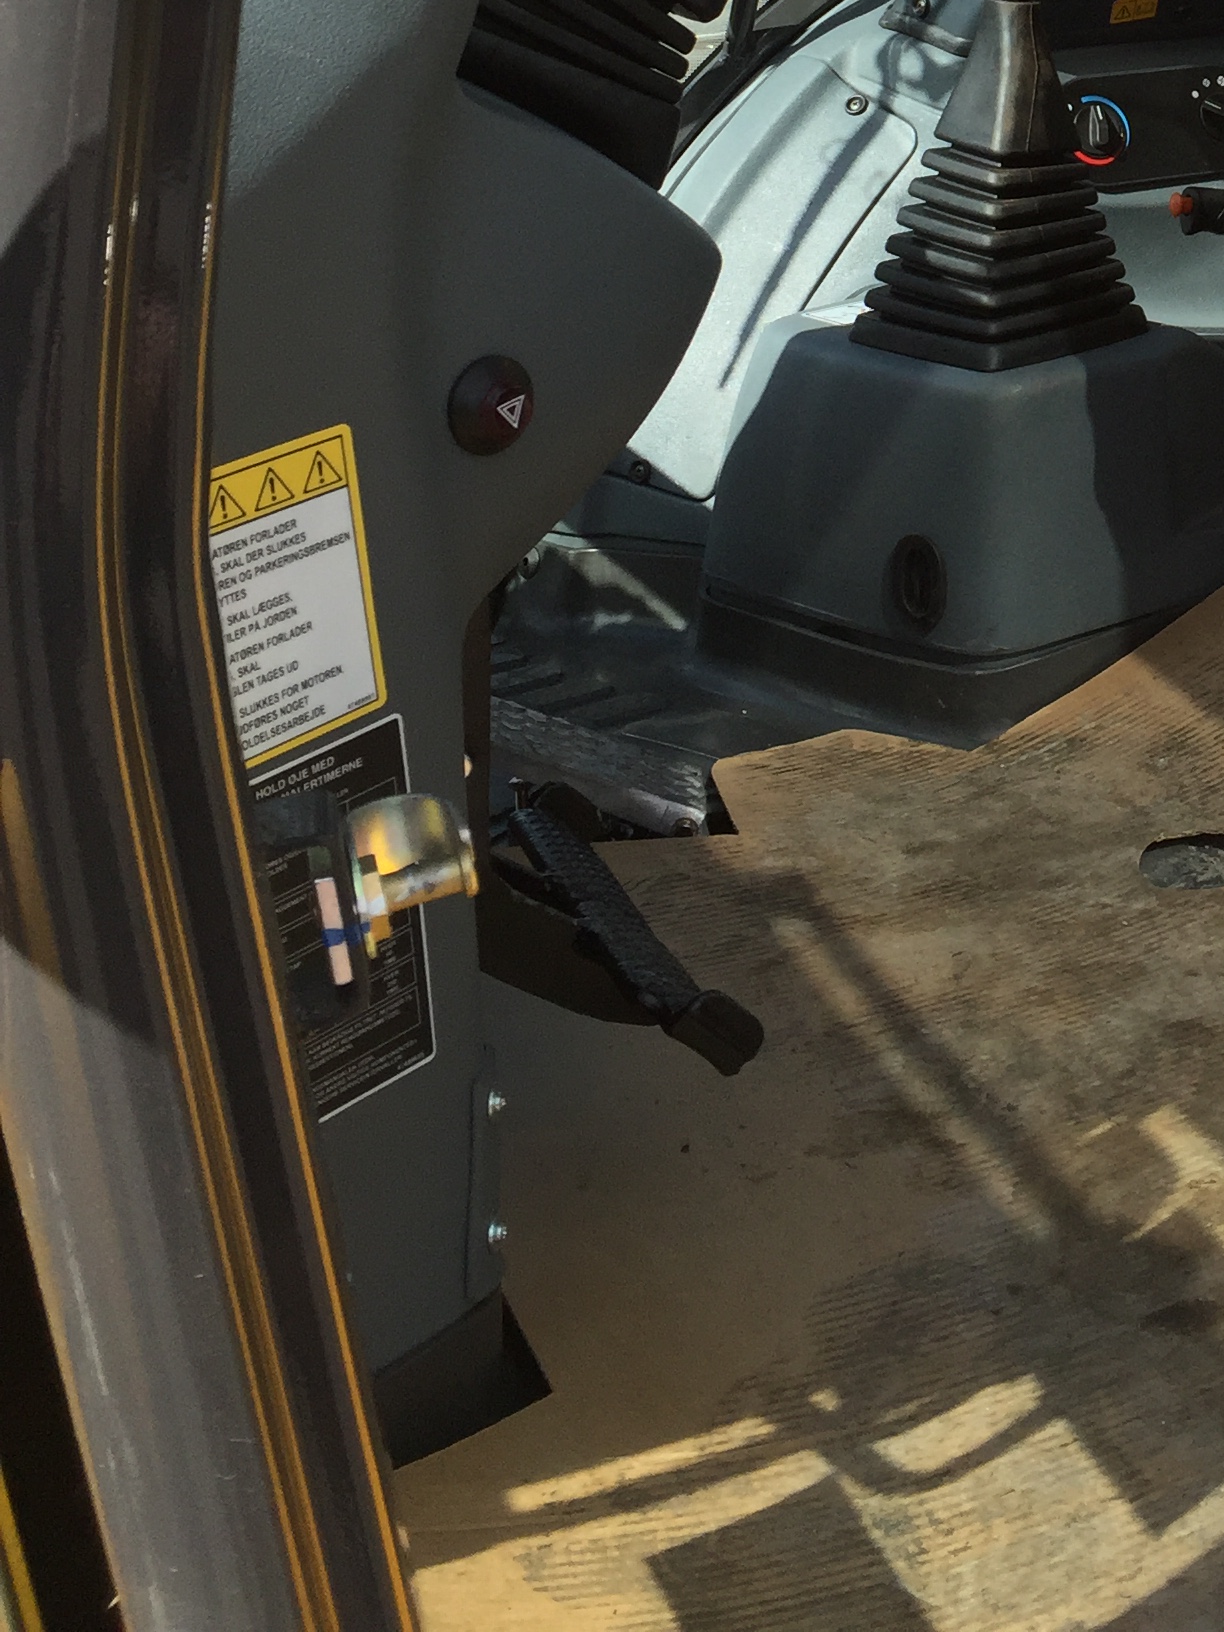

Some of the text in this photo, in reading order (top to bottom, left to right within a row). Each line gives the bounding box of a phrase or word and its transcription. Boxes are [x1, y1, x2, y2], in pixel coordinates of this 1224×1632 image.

[249, 518, 297, 545] FORLADER
[220, 532, 307, 574] SKAL DER SLUKKES
[238, 569, 252, 583] OG
[226, 610, 250, 626] SKAL
[262, 606, 297, 629] JORDEN
[266, 620, 313, 649] FORLADER
[237, 661, 261, 678] SKAL
[256, 666, 285, 686] TAGES
[285, 660, 299, 674] UD
[239, 692, 280, 719] SLUKKES
[281, 684, 300, 699] FOR
[279, 695, 309, 717] NOGET
[255, 779, 286, 801] HOLD
[310, 756, 335, 775] MED
